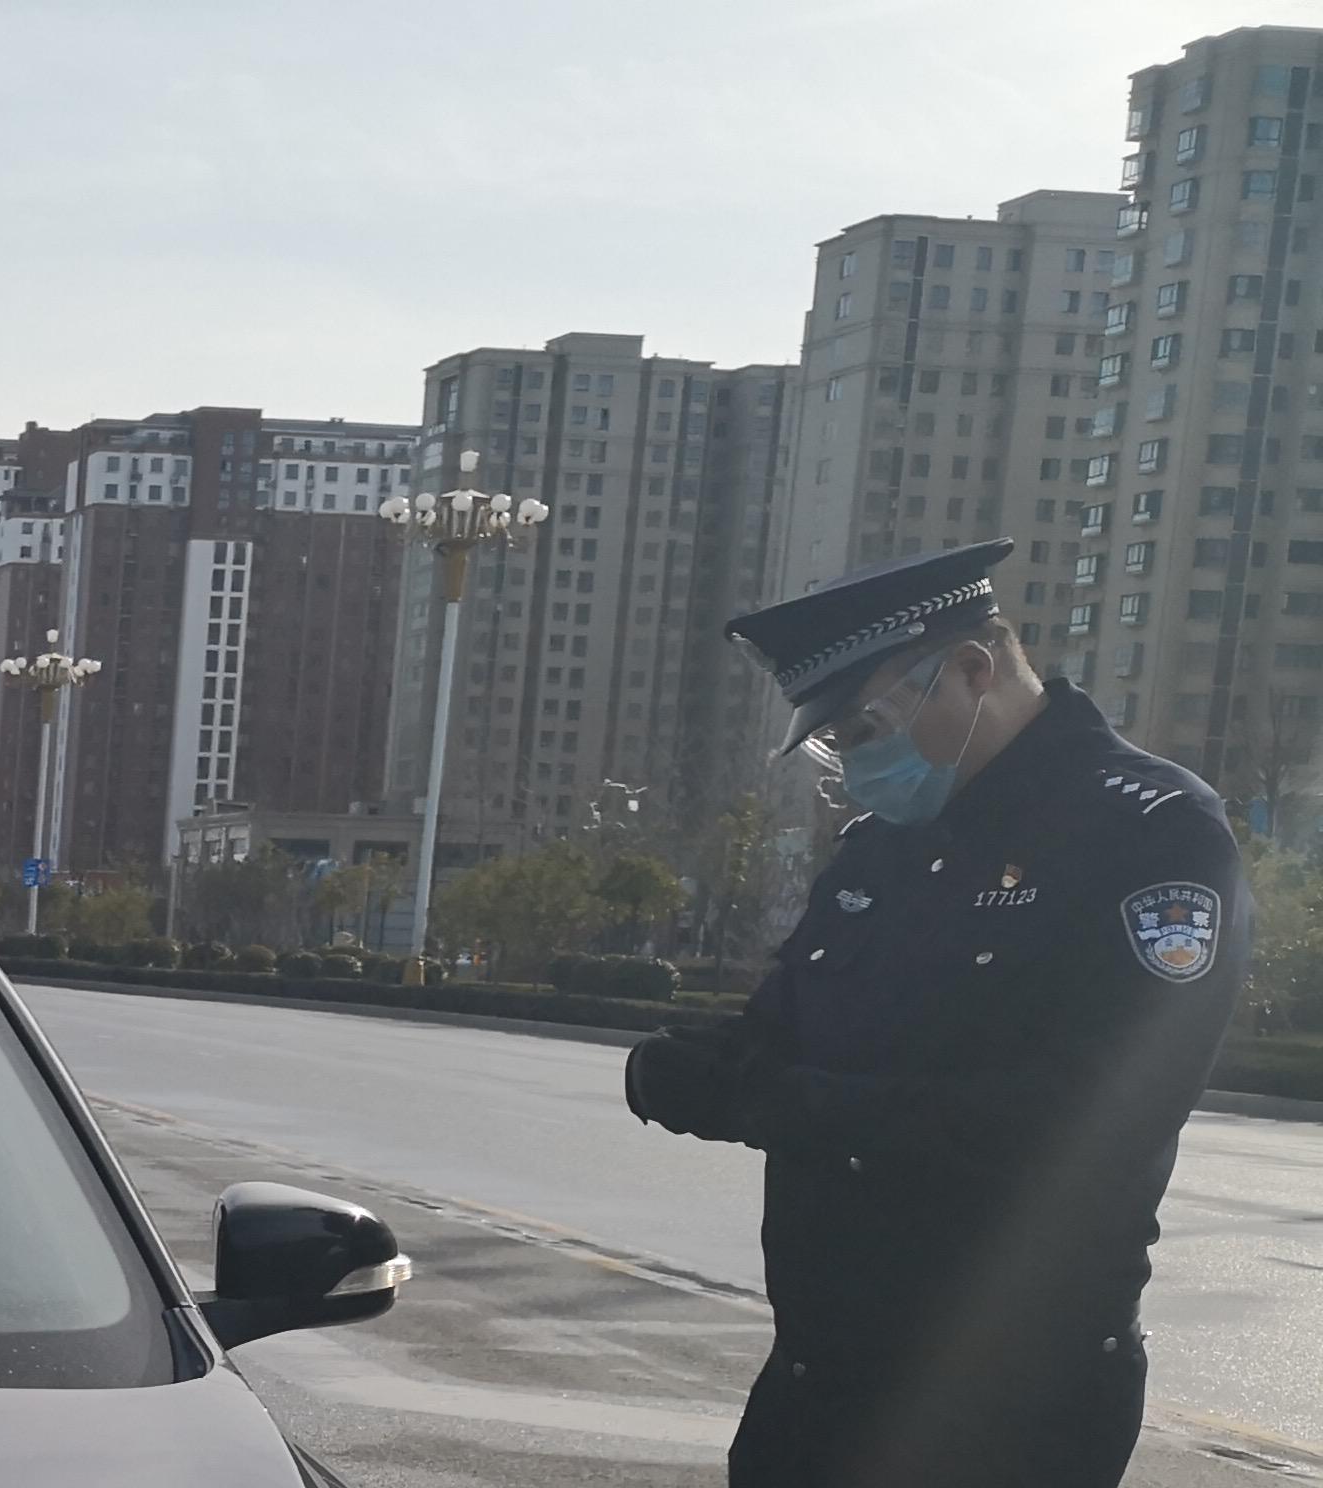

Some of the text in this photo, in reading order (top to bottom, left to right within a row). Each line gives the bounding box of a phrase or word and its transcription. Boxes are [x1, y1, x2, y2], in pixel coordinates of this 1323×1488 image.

[974, 887, 1037, 906] 177123
[1131, 888, 1213, 913] 中华人民共和国
